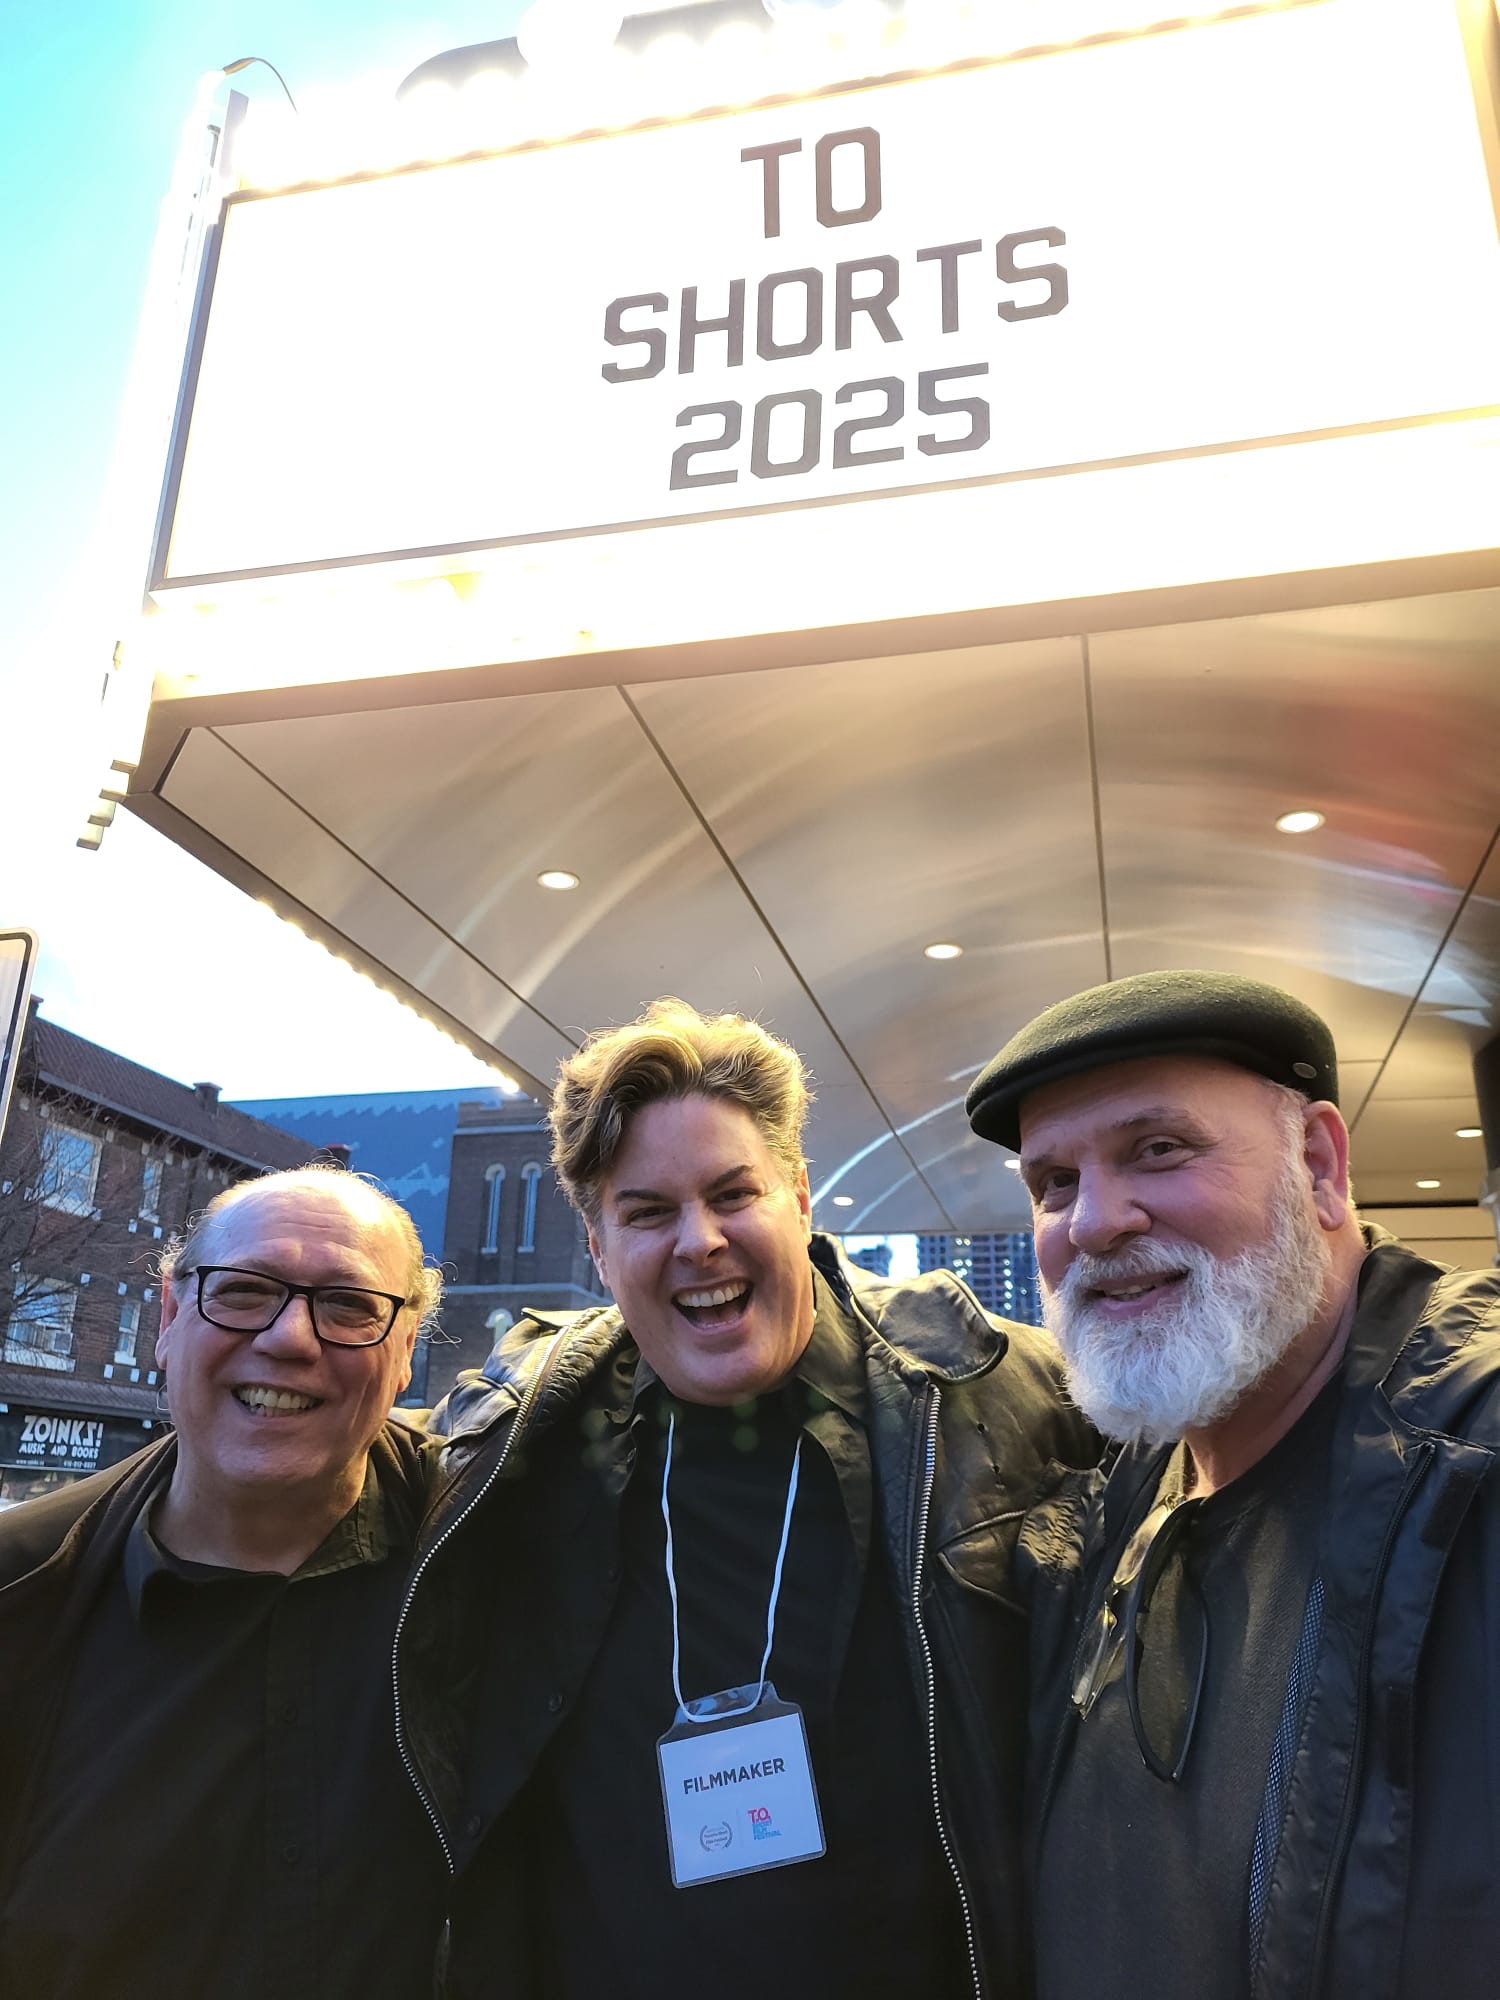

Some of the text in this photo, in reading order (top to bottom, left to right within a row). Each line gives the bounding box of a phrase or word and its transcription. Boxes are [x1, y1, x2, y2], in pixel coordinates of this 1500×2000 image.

[741, 127, 882, 239] TO
[601, 226, 1069, 384] SHORTS
[669, 362, 990, 491] 2025
[18, 1443, 99, 1459] MUSIC AND BOOKS
[20, 1415, 104, 1447] ZOINKS!
[683, 1757, 786, 1795] FILMMAKER
